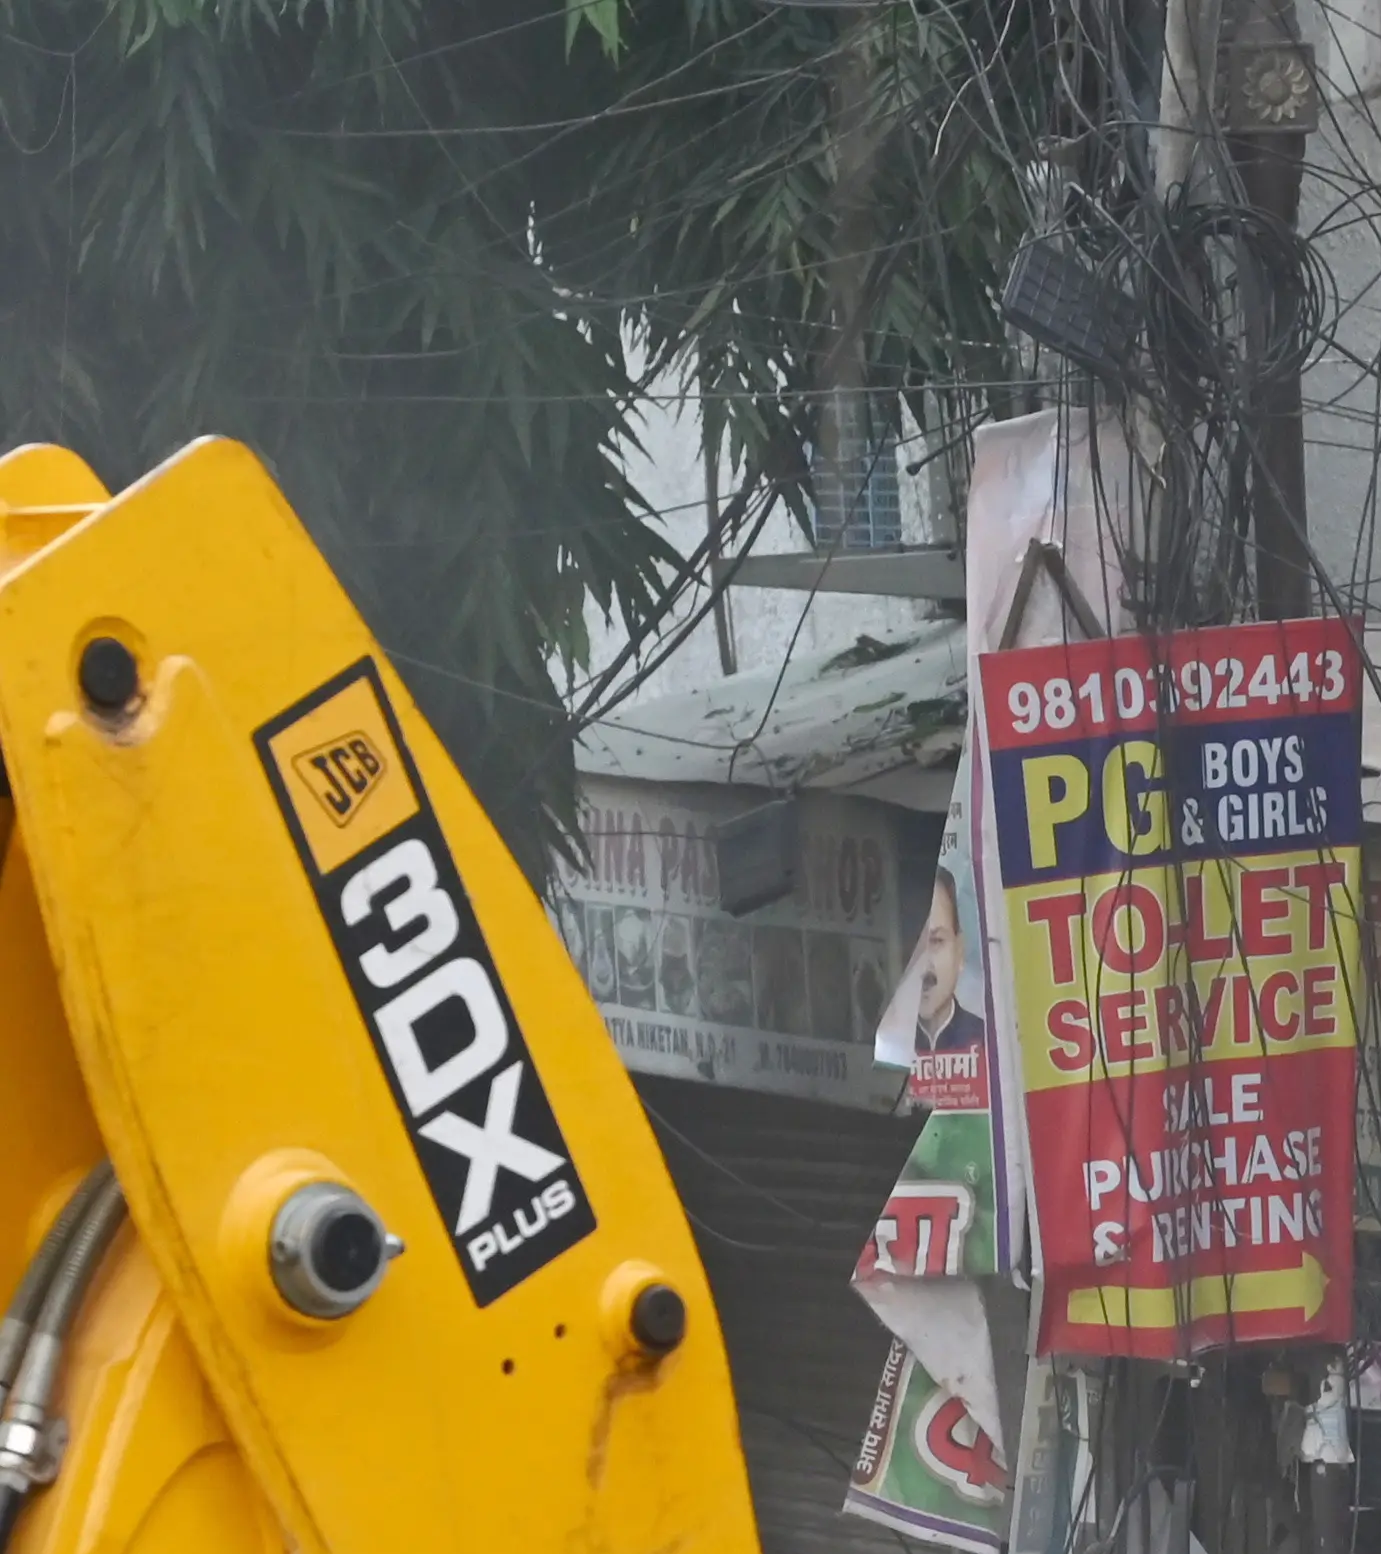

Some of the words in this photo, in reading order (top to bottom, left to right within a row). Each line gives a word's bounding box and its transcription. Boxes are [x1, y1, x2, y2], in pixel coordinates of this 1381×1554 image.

[309, 736, 382, 814] JCB
[1203, 735, 1305, 790] BOYS
[1021, 739, 1172, 869] PG
[1182, 801, 1205, 847] &
[1217, 788, 1329, 843] GIRLS
[340, 838, 567, 1237] 3DX
[466, 1179, 576, 1272] PLUS
[1046, 966, 1338, 1072] SERVICE
[1162, 1072, 1263, 1128] SALE
[1083, 1126, 1324, 1211] PURCHASE
[1092, 1220, 1131, 1268] &
[1153, 1197, 1326, 1265] RENTING
